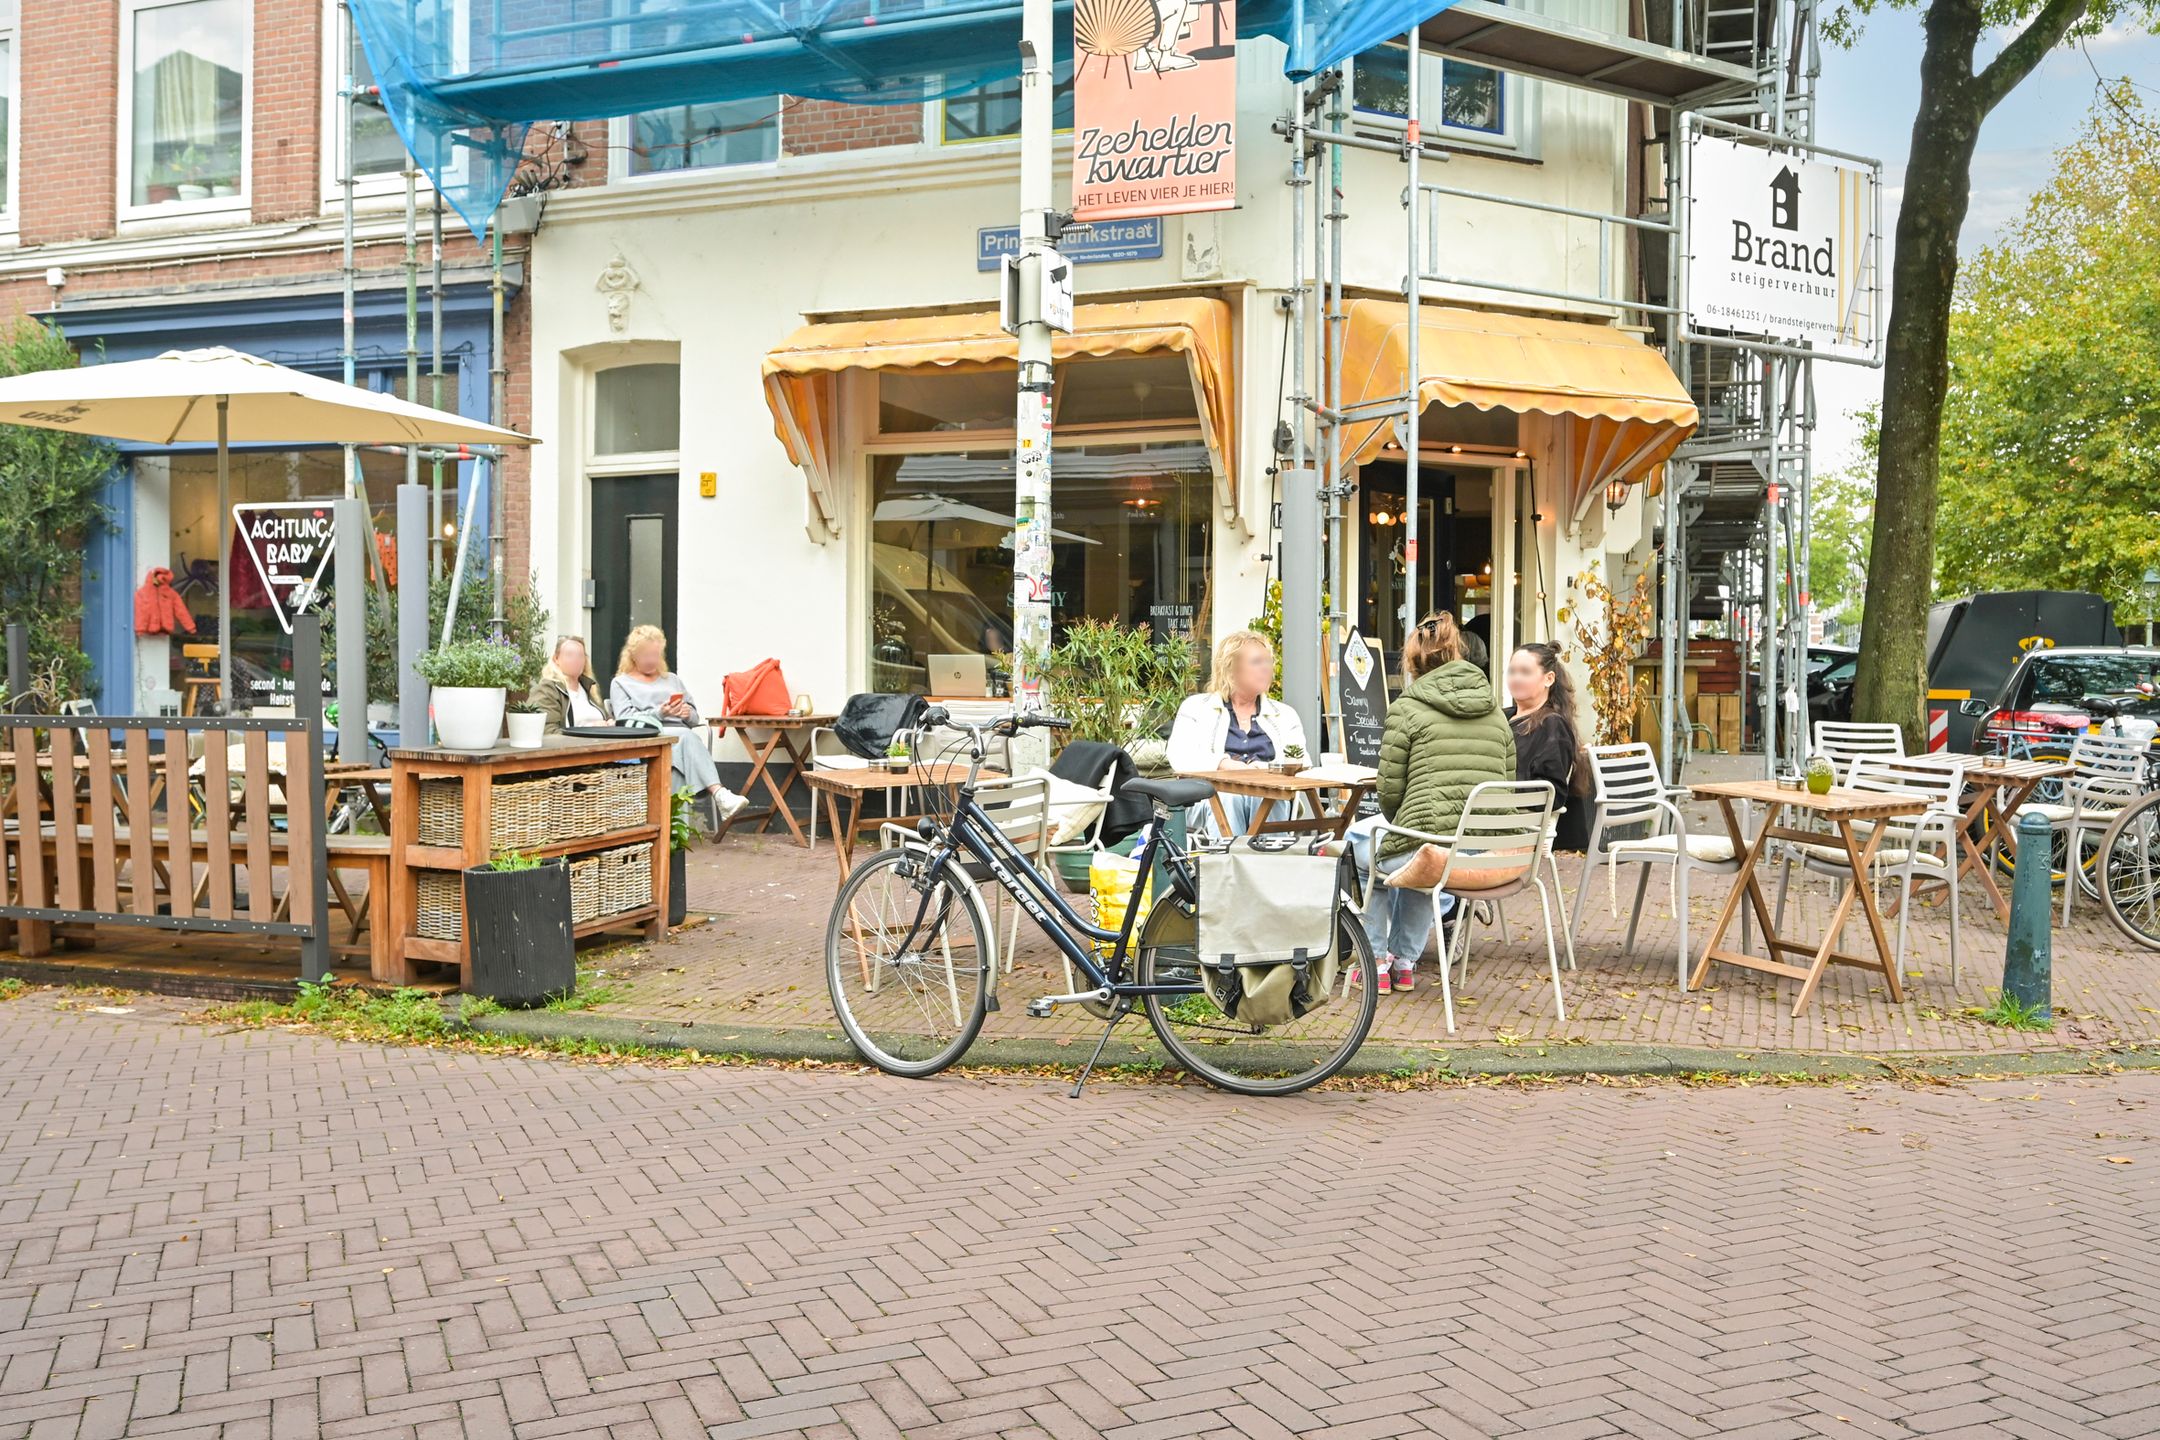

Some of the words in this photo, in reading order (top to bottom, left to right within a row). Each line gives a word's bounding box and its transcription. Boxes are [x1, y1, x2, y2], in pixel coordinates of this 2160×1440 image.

[1078, 114, 1232, 159] Zeehelden
[1085, 147, 1231, 184] kwartier
[1078, 193, 1103, 207] HET
[1106, 189, 1147, 204] LEVEN
[1150, 186, 1179, 200] VIER
[1183, 184, 1196, 198] JE
[1200, 181, 1234, 196] HIER!
[985, 234, 1020, 251] Prin
[1731, 219, 1836, 278] Brand
[1731, 270, 1836, 298] steigerverhuur
[1706, 304, 1760, 321] 06-18461251
[1762, 314, 1767, 323] /
[1769, 314, 1856, 336] brandsteigerverhuur.nl
[251, 518, 335, 549] ACHTUNG!
[267, 543, 314, 563] BABY
[1150, 605, 1174, 616] BREAKFAST
[1179, 605, 1194, 616] LUNCH
[1179, 617, 1191, 629] AWA
[250, 677, 275, 691] second
[269, 692, 295, 706] Hairst
